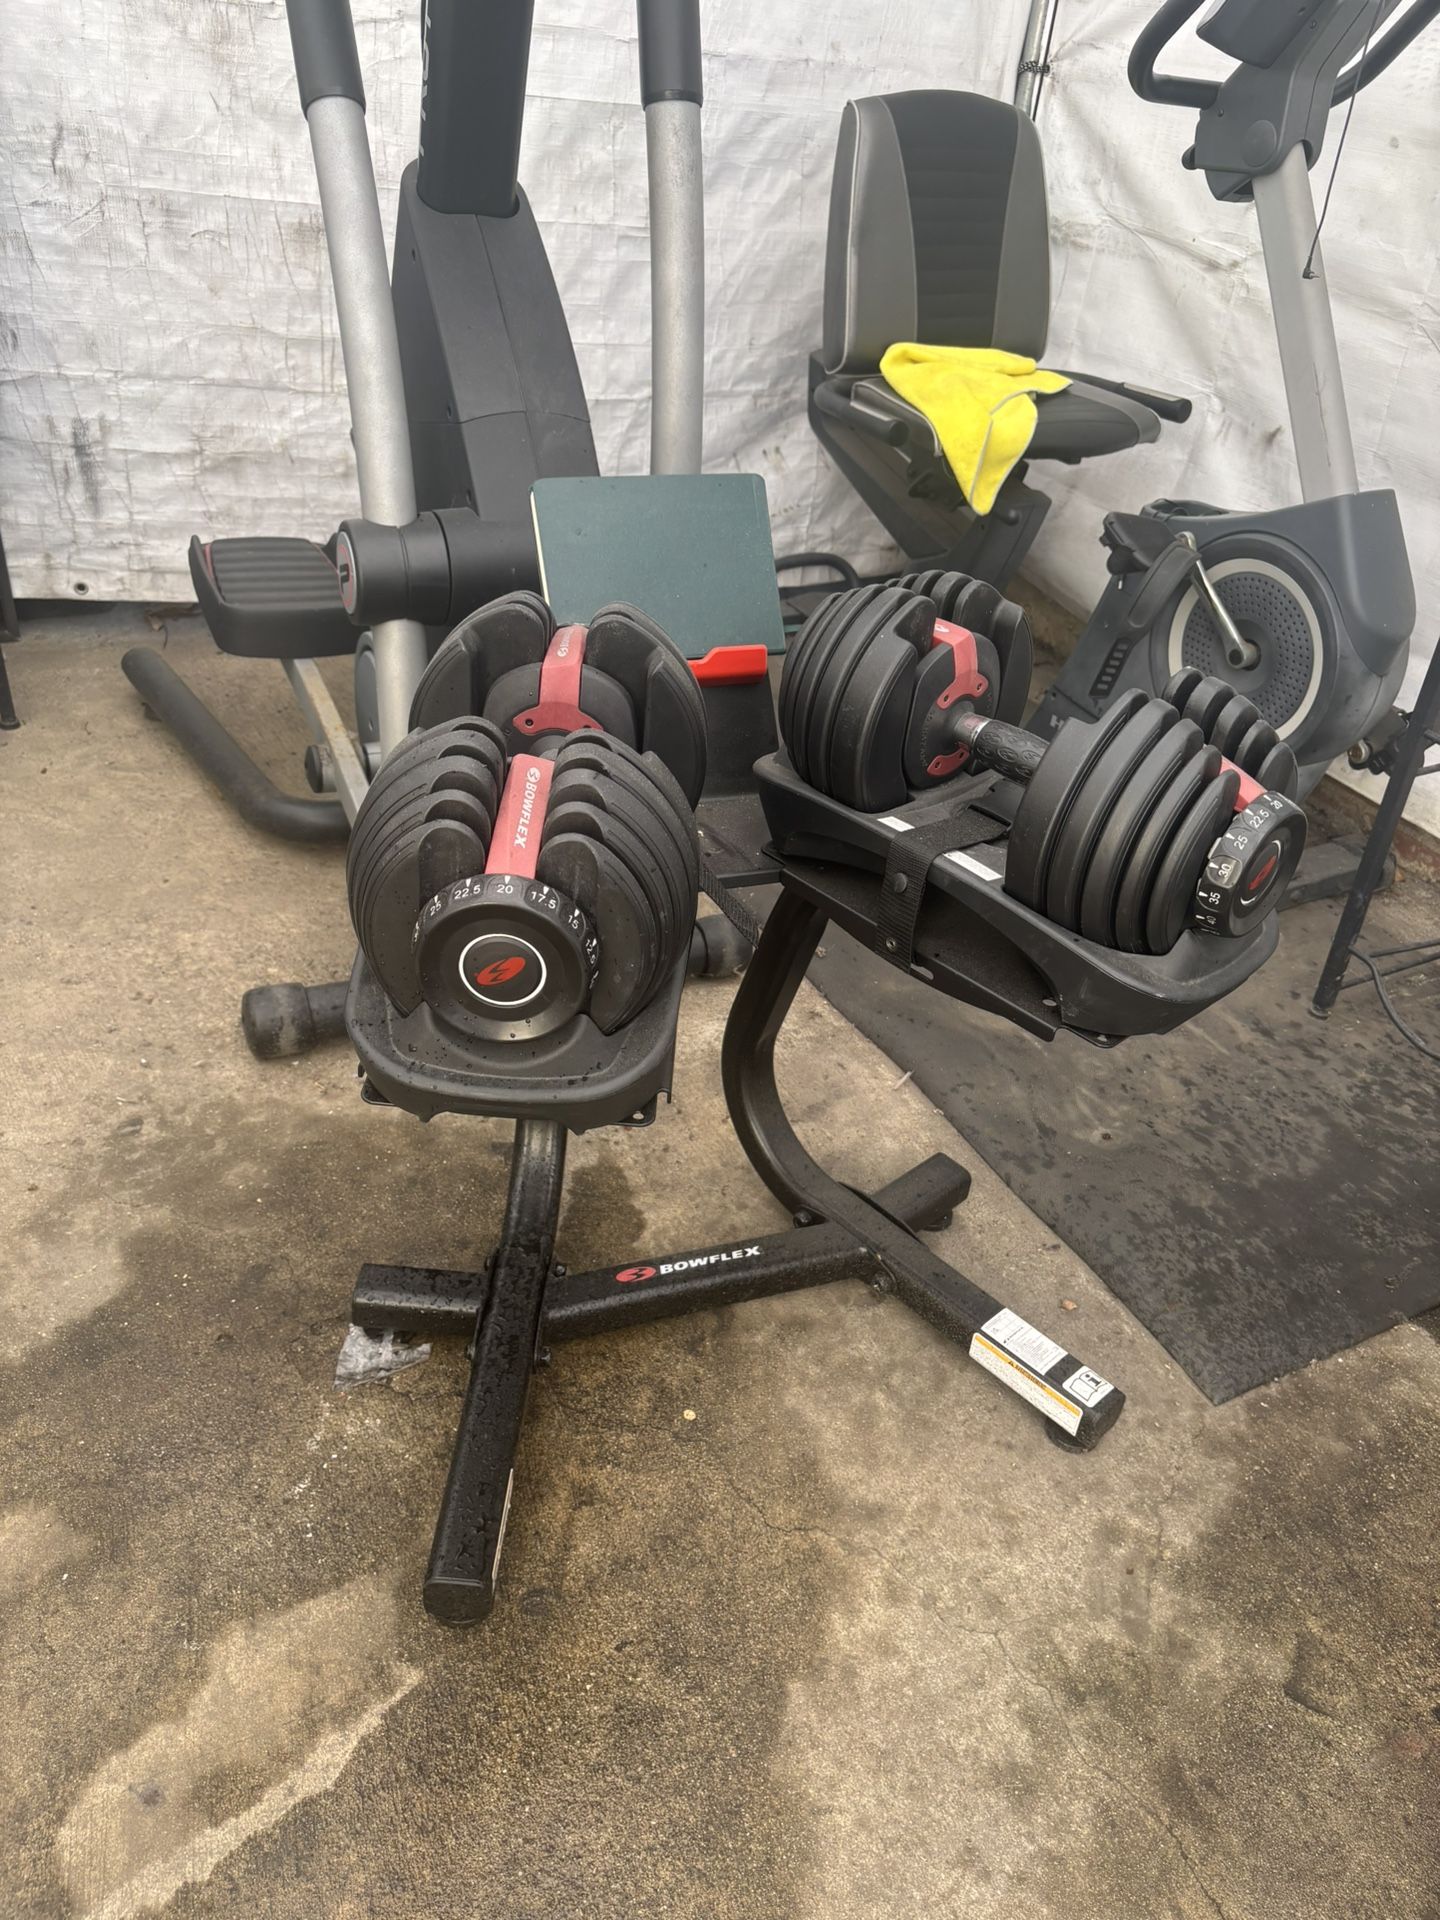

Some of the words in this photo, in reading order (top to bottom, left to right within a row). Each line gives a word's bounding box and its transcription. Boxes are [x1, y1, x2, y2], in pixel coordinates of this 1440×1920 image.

[513, 782, 538, 849] BOWFLEX
[1249, 809, 1270, 829] 22.5
[1233, 834, 1249, 851] 25
[1218, 863, 1233, 879] 30
[454, 884, 482, 900] 22.5
[496, 884, 514, 895] 20
[530, 891, 557, 910] 17.5
[1208, 892, 1221, 906] 35
[430, 900, 442, 917] 25
[568, 914, 580, 930] 15
[659, 1246, 761, 1275] BOWFLEX
